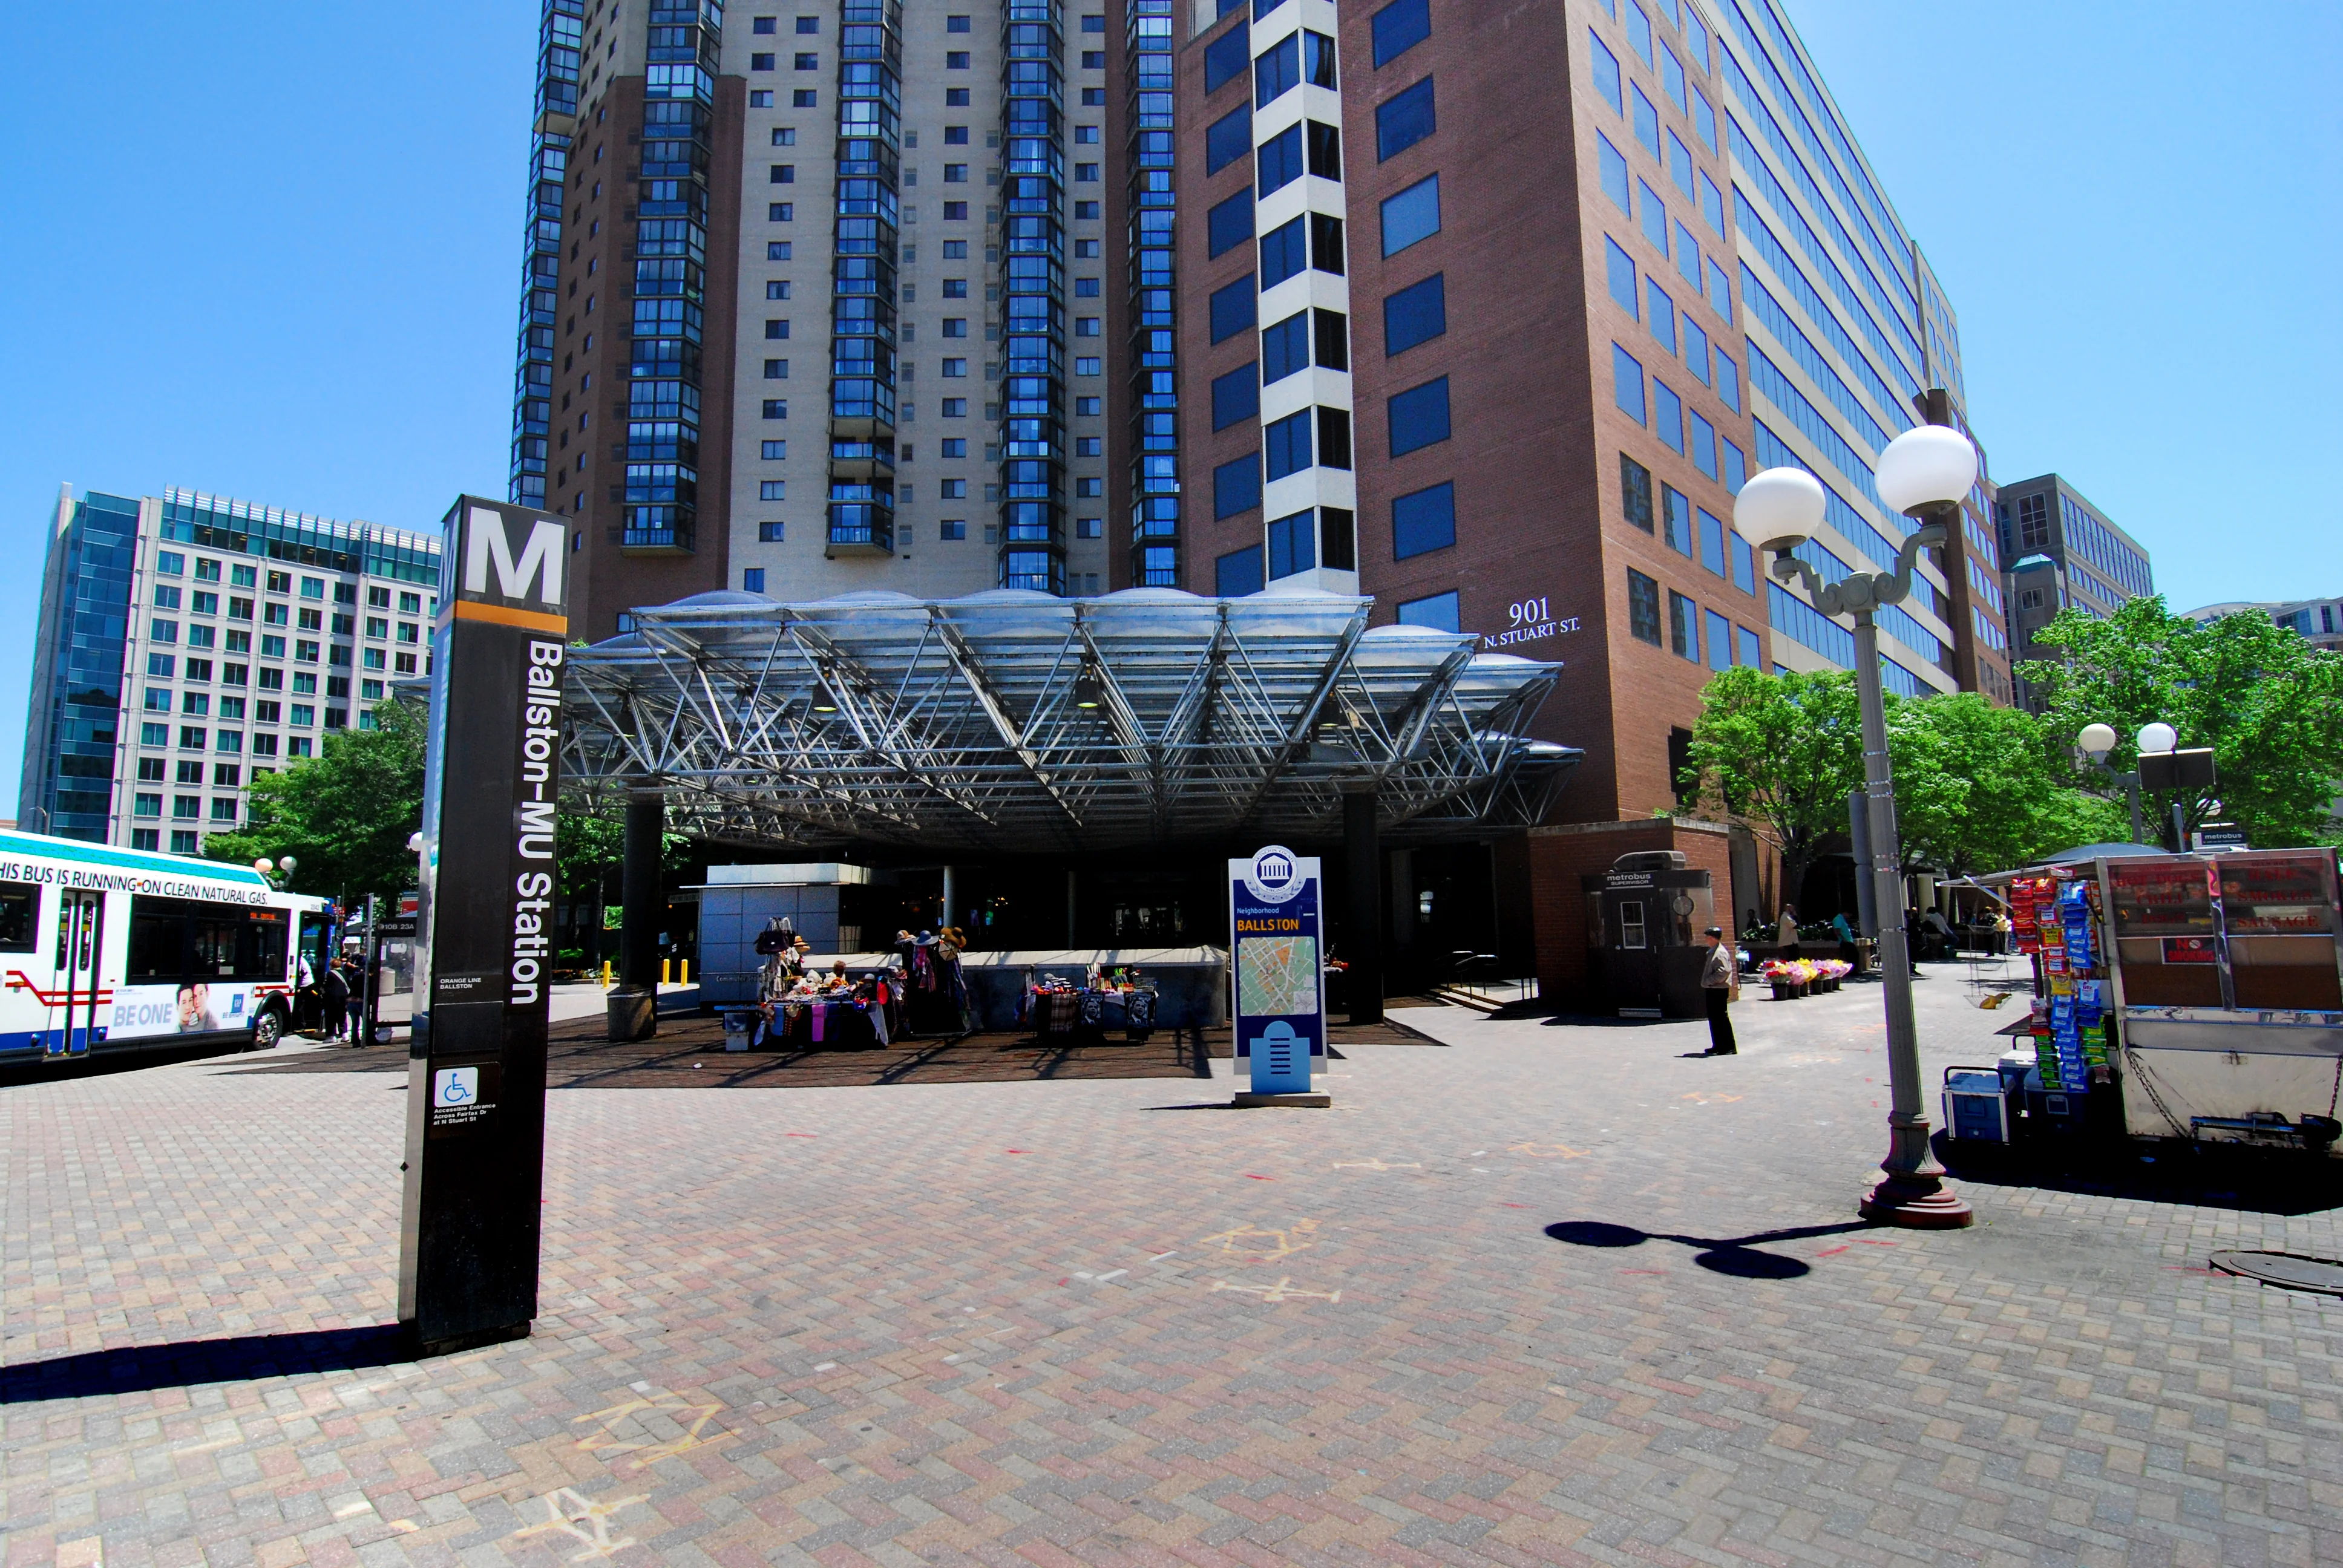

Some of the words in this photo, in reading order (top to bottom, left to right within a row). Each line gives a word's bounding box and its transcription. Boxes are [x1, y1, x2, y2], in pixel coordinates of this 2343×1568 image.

[465, 506, 565, 605] M
[1509, 596, 1550, 627] 901
[1484, 635, 1497, 648] N.
[1500, 622, 1556, 645] STUART
[1560, 618, 1581, 633] ST.
[519, 640, 563, 859] Ballston-MU
[23, 865, 53, 883] BUS
[57, 869, 69, 884] IS
[73, 871, 137, 891] RUNNING
[142, 880, 161, 894] ON
[164, 882, 200, 898] CLEAN
[202, 887, 247, 903] NATURAL
[249, 892, 267, 904] GAS.
[1237, 919, 1299, 931] BALLSTON
[2236, 915, 2319, 927] SAUSAGE
[512, 872, 552, 1004] Station
[2168, 950, 2215, 962] SMOKING
[114, 1005, 137, 1027] BE
[139, 1003, 173, 1025] ONE
